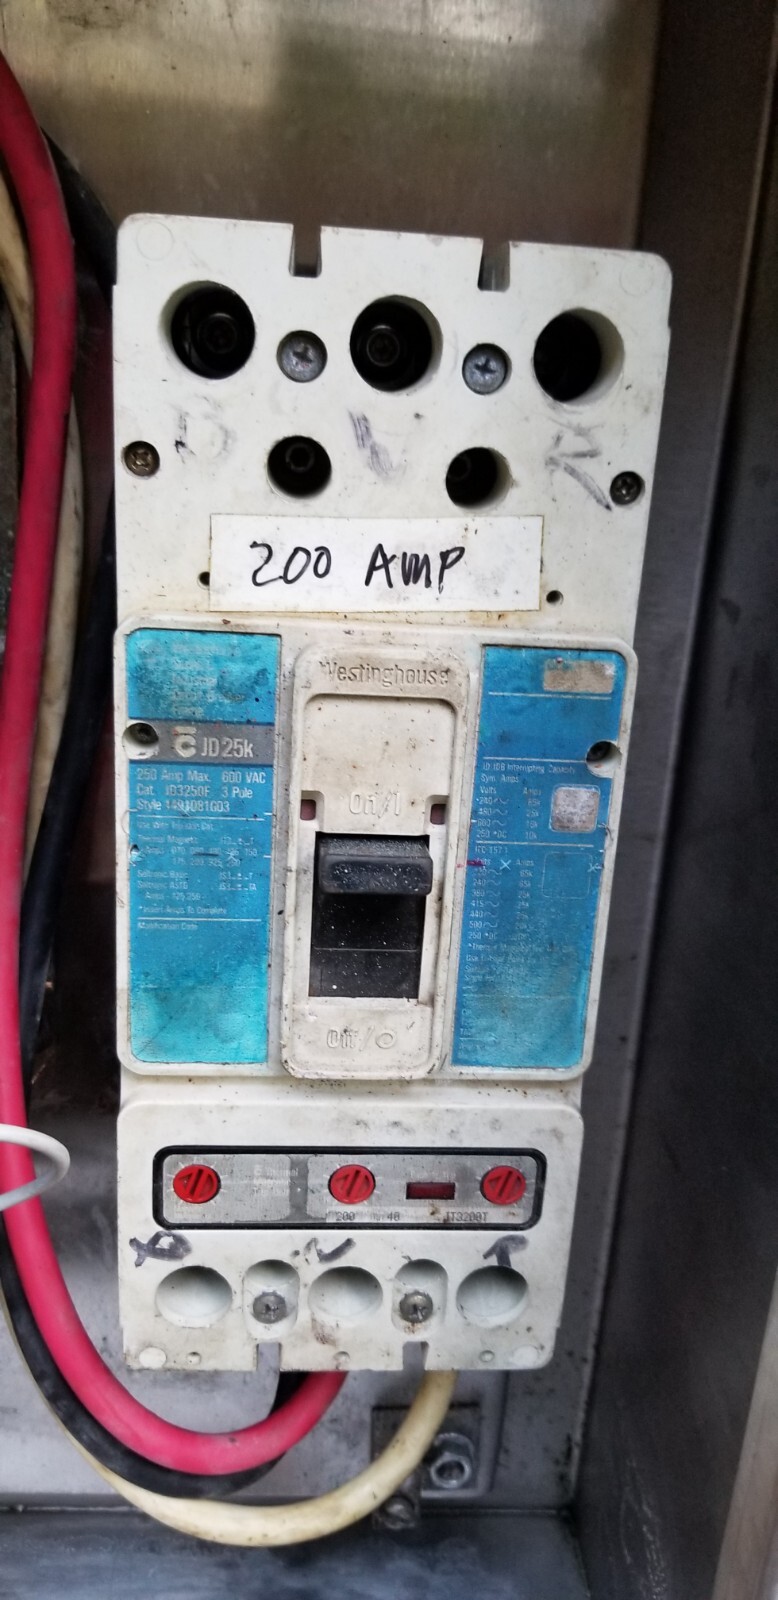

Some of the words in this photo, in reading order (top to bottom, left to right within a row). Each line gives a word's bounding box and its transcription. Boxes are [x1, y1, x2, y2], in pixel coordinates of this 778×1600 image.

[250, 541, 331, 587] 200
[319, 661, 451, 688] Westinghouse
[221, 772, 242, 784] 600
[245, 772, 267, 785] VAC
[222, 787, 229, 798] 3
[232, 787, 254, 799] Pole
[136, 799, 162, 813] Style
